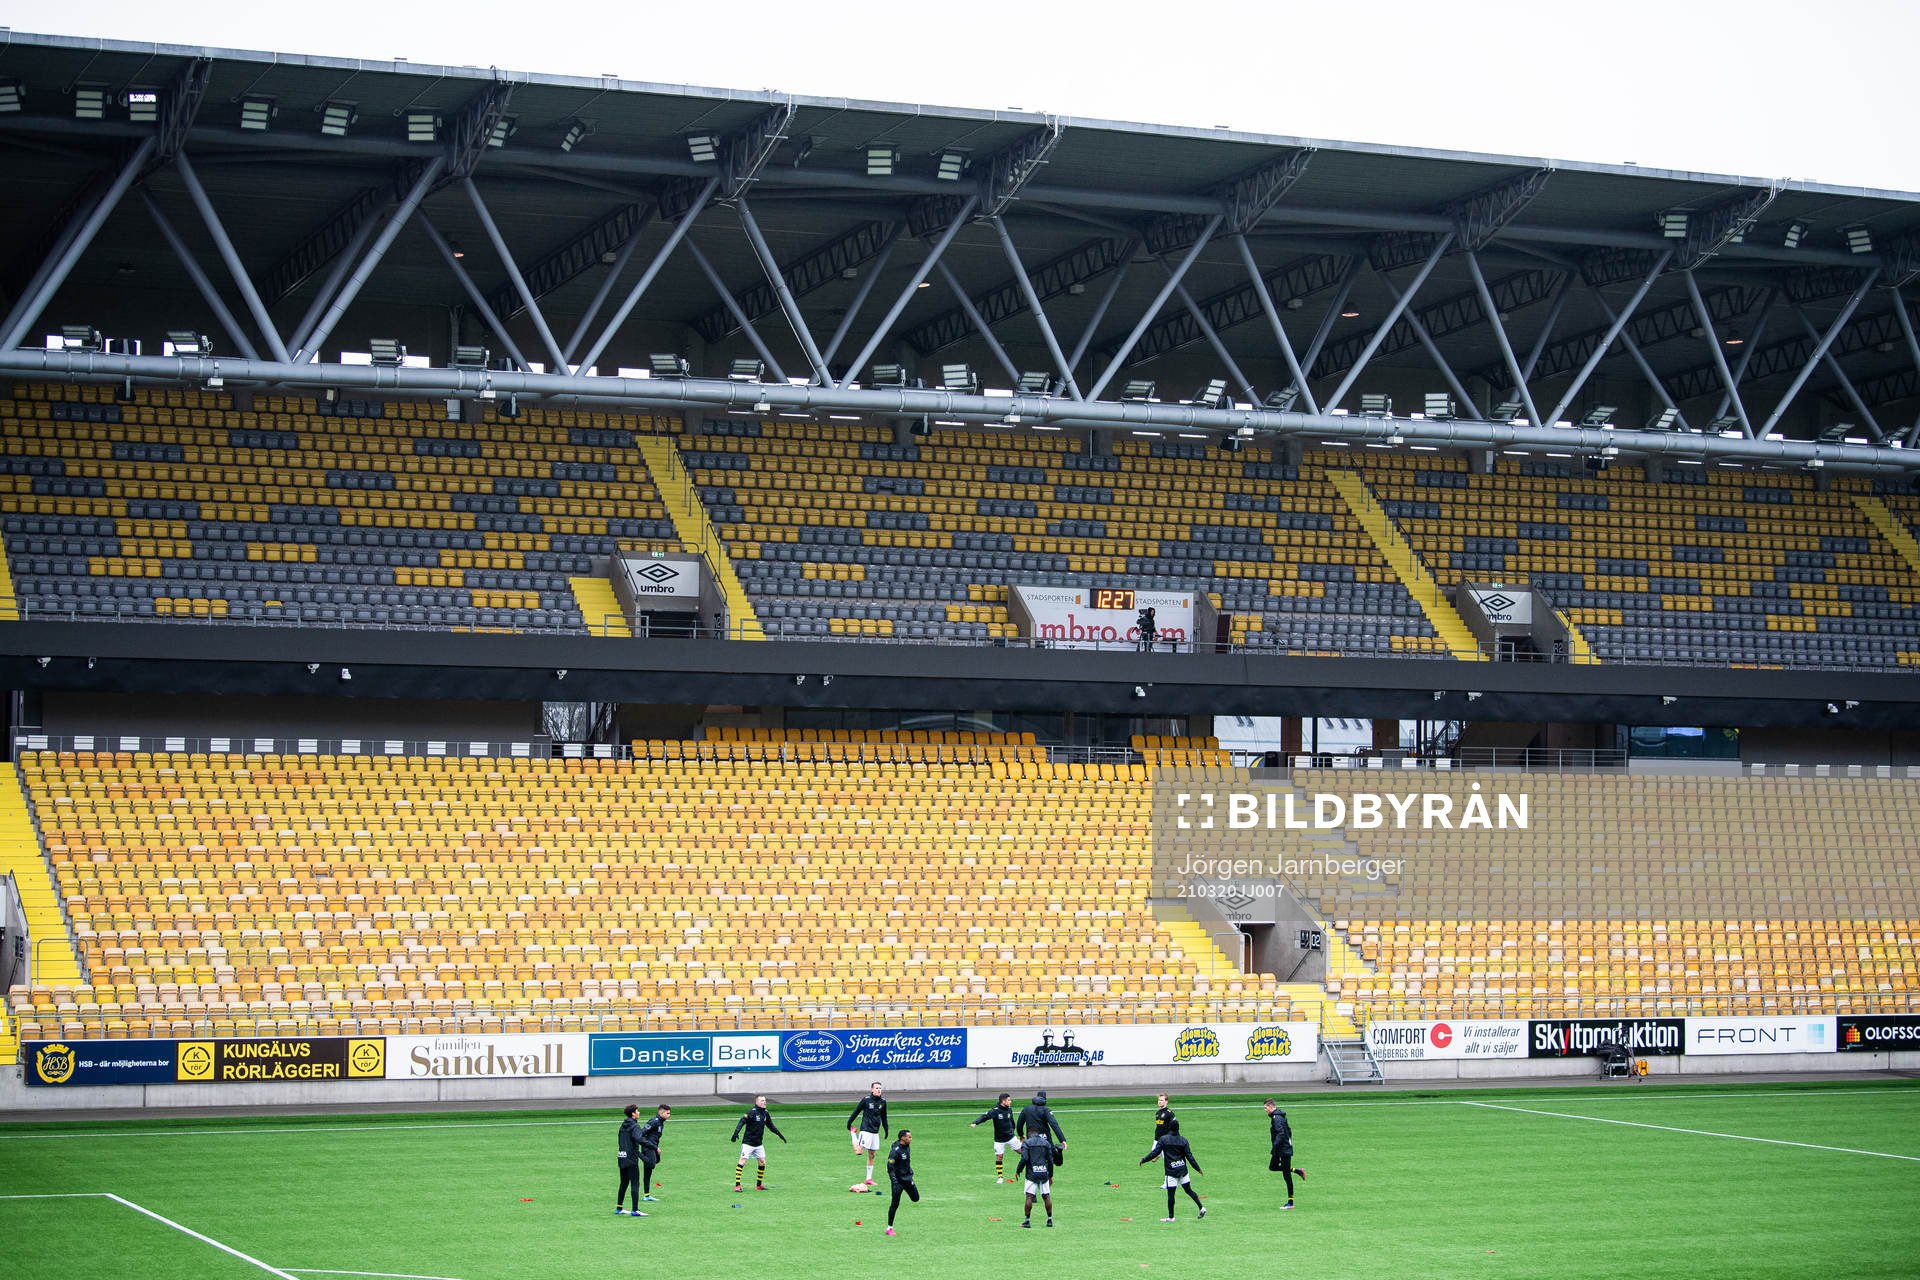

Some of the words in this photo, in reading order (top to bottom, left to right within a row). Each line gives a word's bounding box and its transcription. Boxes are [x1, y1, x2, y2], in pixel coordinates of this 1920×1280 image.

[640, 585, 675, 593] umbro
[1027, 594, 1074, 602] STADSPORTEN
[1135, 598, 1181, 606] STADSPORTEN
[1034, 614, 1185, 645] mbro.cm
[1225, 911, 1252, 920] mbro
[1373, 1028, 1427, 1045] COMFORT
[1463, 1025, 1473, 1037] Vi
[1473, 1025, 1521, 1037] installerar
[1697, 1027, 1797, 1044] FRONT
[434, 1037, 482, 1053] familjen
[794, 1038, 833, 1047] Sjömarkens
[845, 1031, 922, 1054] Sjömarkens
[924, 1032, 963, 1047] Svets
[1244, 1036, 1292, 1061] Landet
[1464, 1041, 1480, 1054] allt
[1482, 1041, 1491, 1053] vi
[1492, 1041, 1519, 1056] säljer
[193, 1051, 201, 1060] K
[223, 1041, 311, 1059] KUNGÄLVS
[363, 1048, 370, 1057] K
[619, 1045, 705, 1063] Danske
[718, 1044, 772, 1061] Bank
[797, 1047, 817, 1055] Svets
[817, 1046, 830, 1054] och
[856, 1048, 880, 1064] och
[882, 1048, 925, 1065] Smide
[926, 1049, 952, 1063] AB
[1172, 1038, 1220, 1062] Landet
[1410, 1047, 1425, 1058] RÖR
[78, 1060, 93, 1068] HSB
[111, 1059, 157, 1068] möjligheterna
[158, 1059, 170, 1067] bor
[360, 1060, 373, 1068] rör
[410, 1043, 566, 1077] Sandwall
[796, 1055, 818, 1063] Smide
[1011, 1050, 1082, 1065] Bygg-bröderna
[190, 1063, 203, 1071] rör
[223, 1062, 340, 1080] RÖRLÄGGERI
